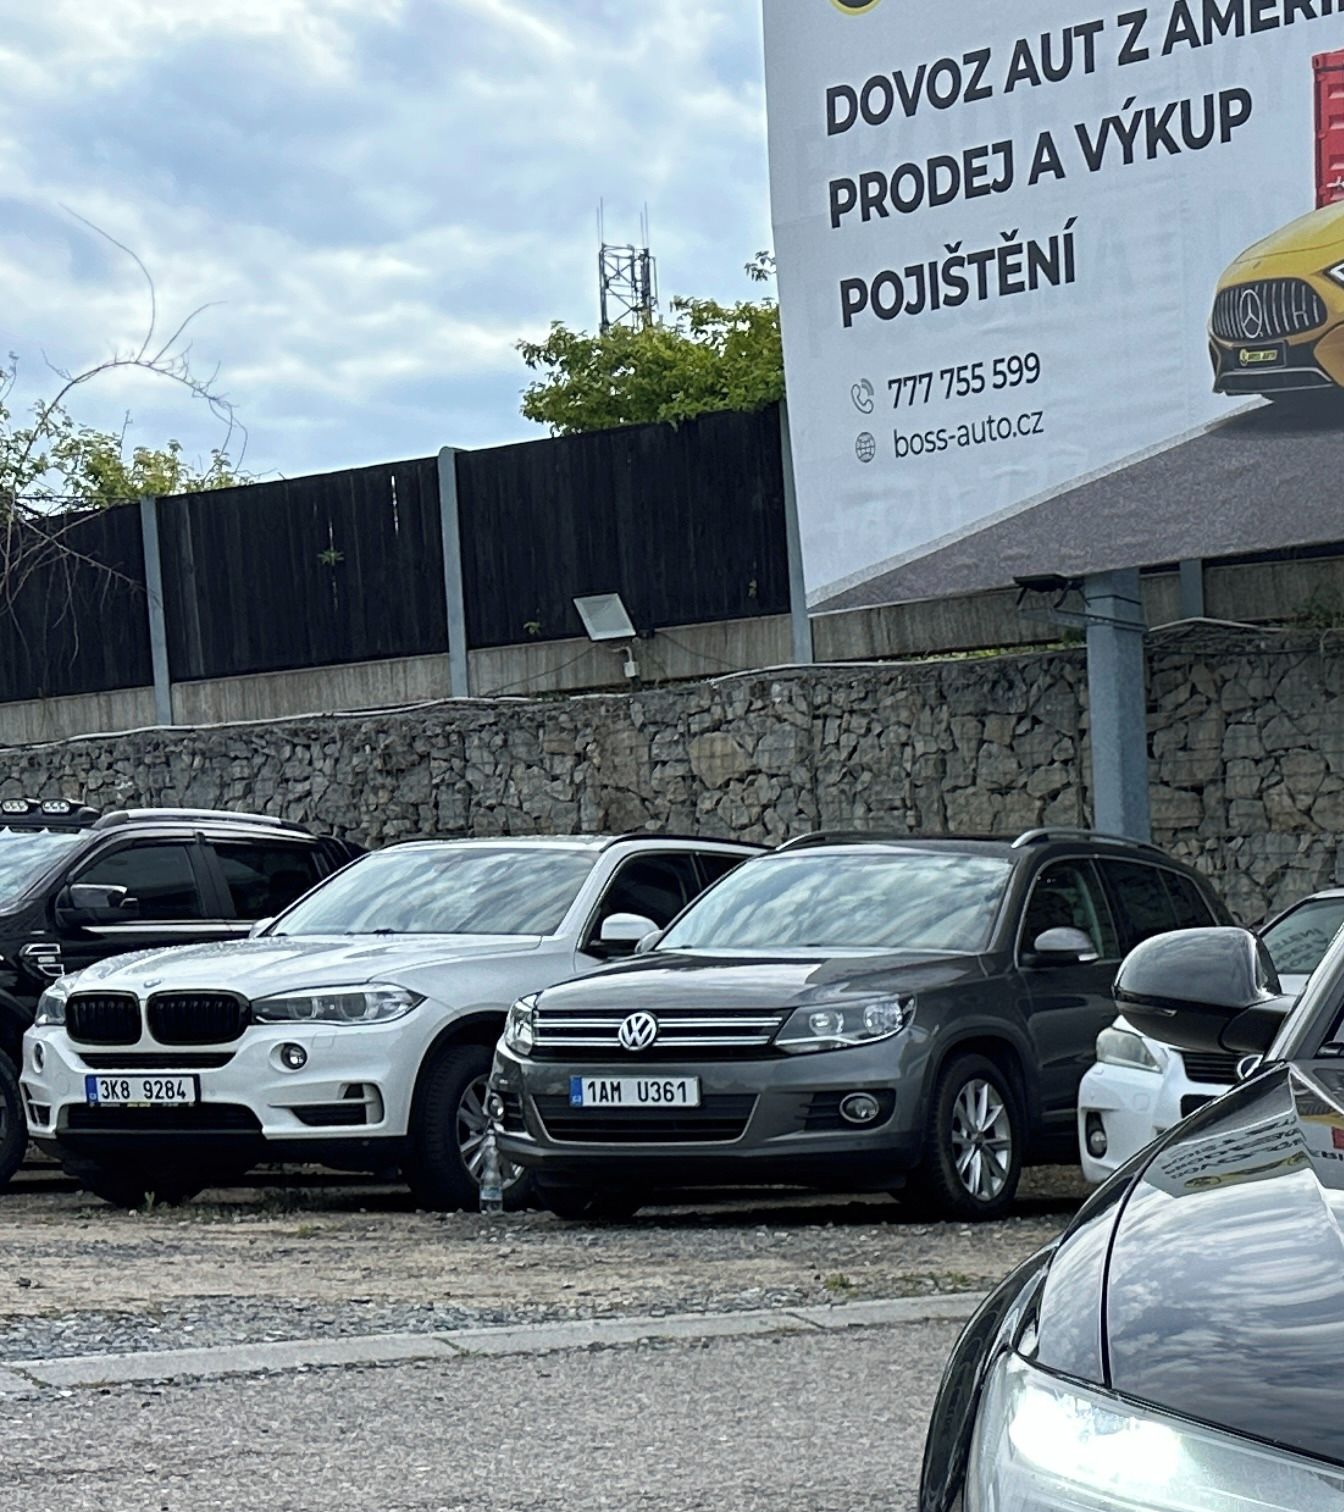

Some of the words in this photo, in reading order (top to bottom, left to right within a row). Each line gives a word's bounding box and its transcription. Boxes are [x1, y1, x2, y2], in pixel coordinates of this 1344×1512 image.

[826, 47, 993, 137] DOVOZ
[1003, 19, 1104, 94] AUT
[1117, 8, 1150, 66] Z
[828, 139, 1014, 229] PRODEJ
[1028, 131, 1066, 186] A
[1074, 87, 1253, 172] VÝKUP
[839, 216, 1079, 328] POJIŠTĚNÍ
[887, 371, 934, 409] 777
[940, 362, 986, 400] 755
[992, 352, 1041, 390] 599
[893, 410, 1045, 459] boss-auto.cz
[100, 1079, 131, 1100] 3K8
[143, 1079, 187, 1100] 9284
[587, 1080, 622, 1103] 1AM
[636, 1080, 688, 1103] U361
